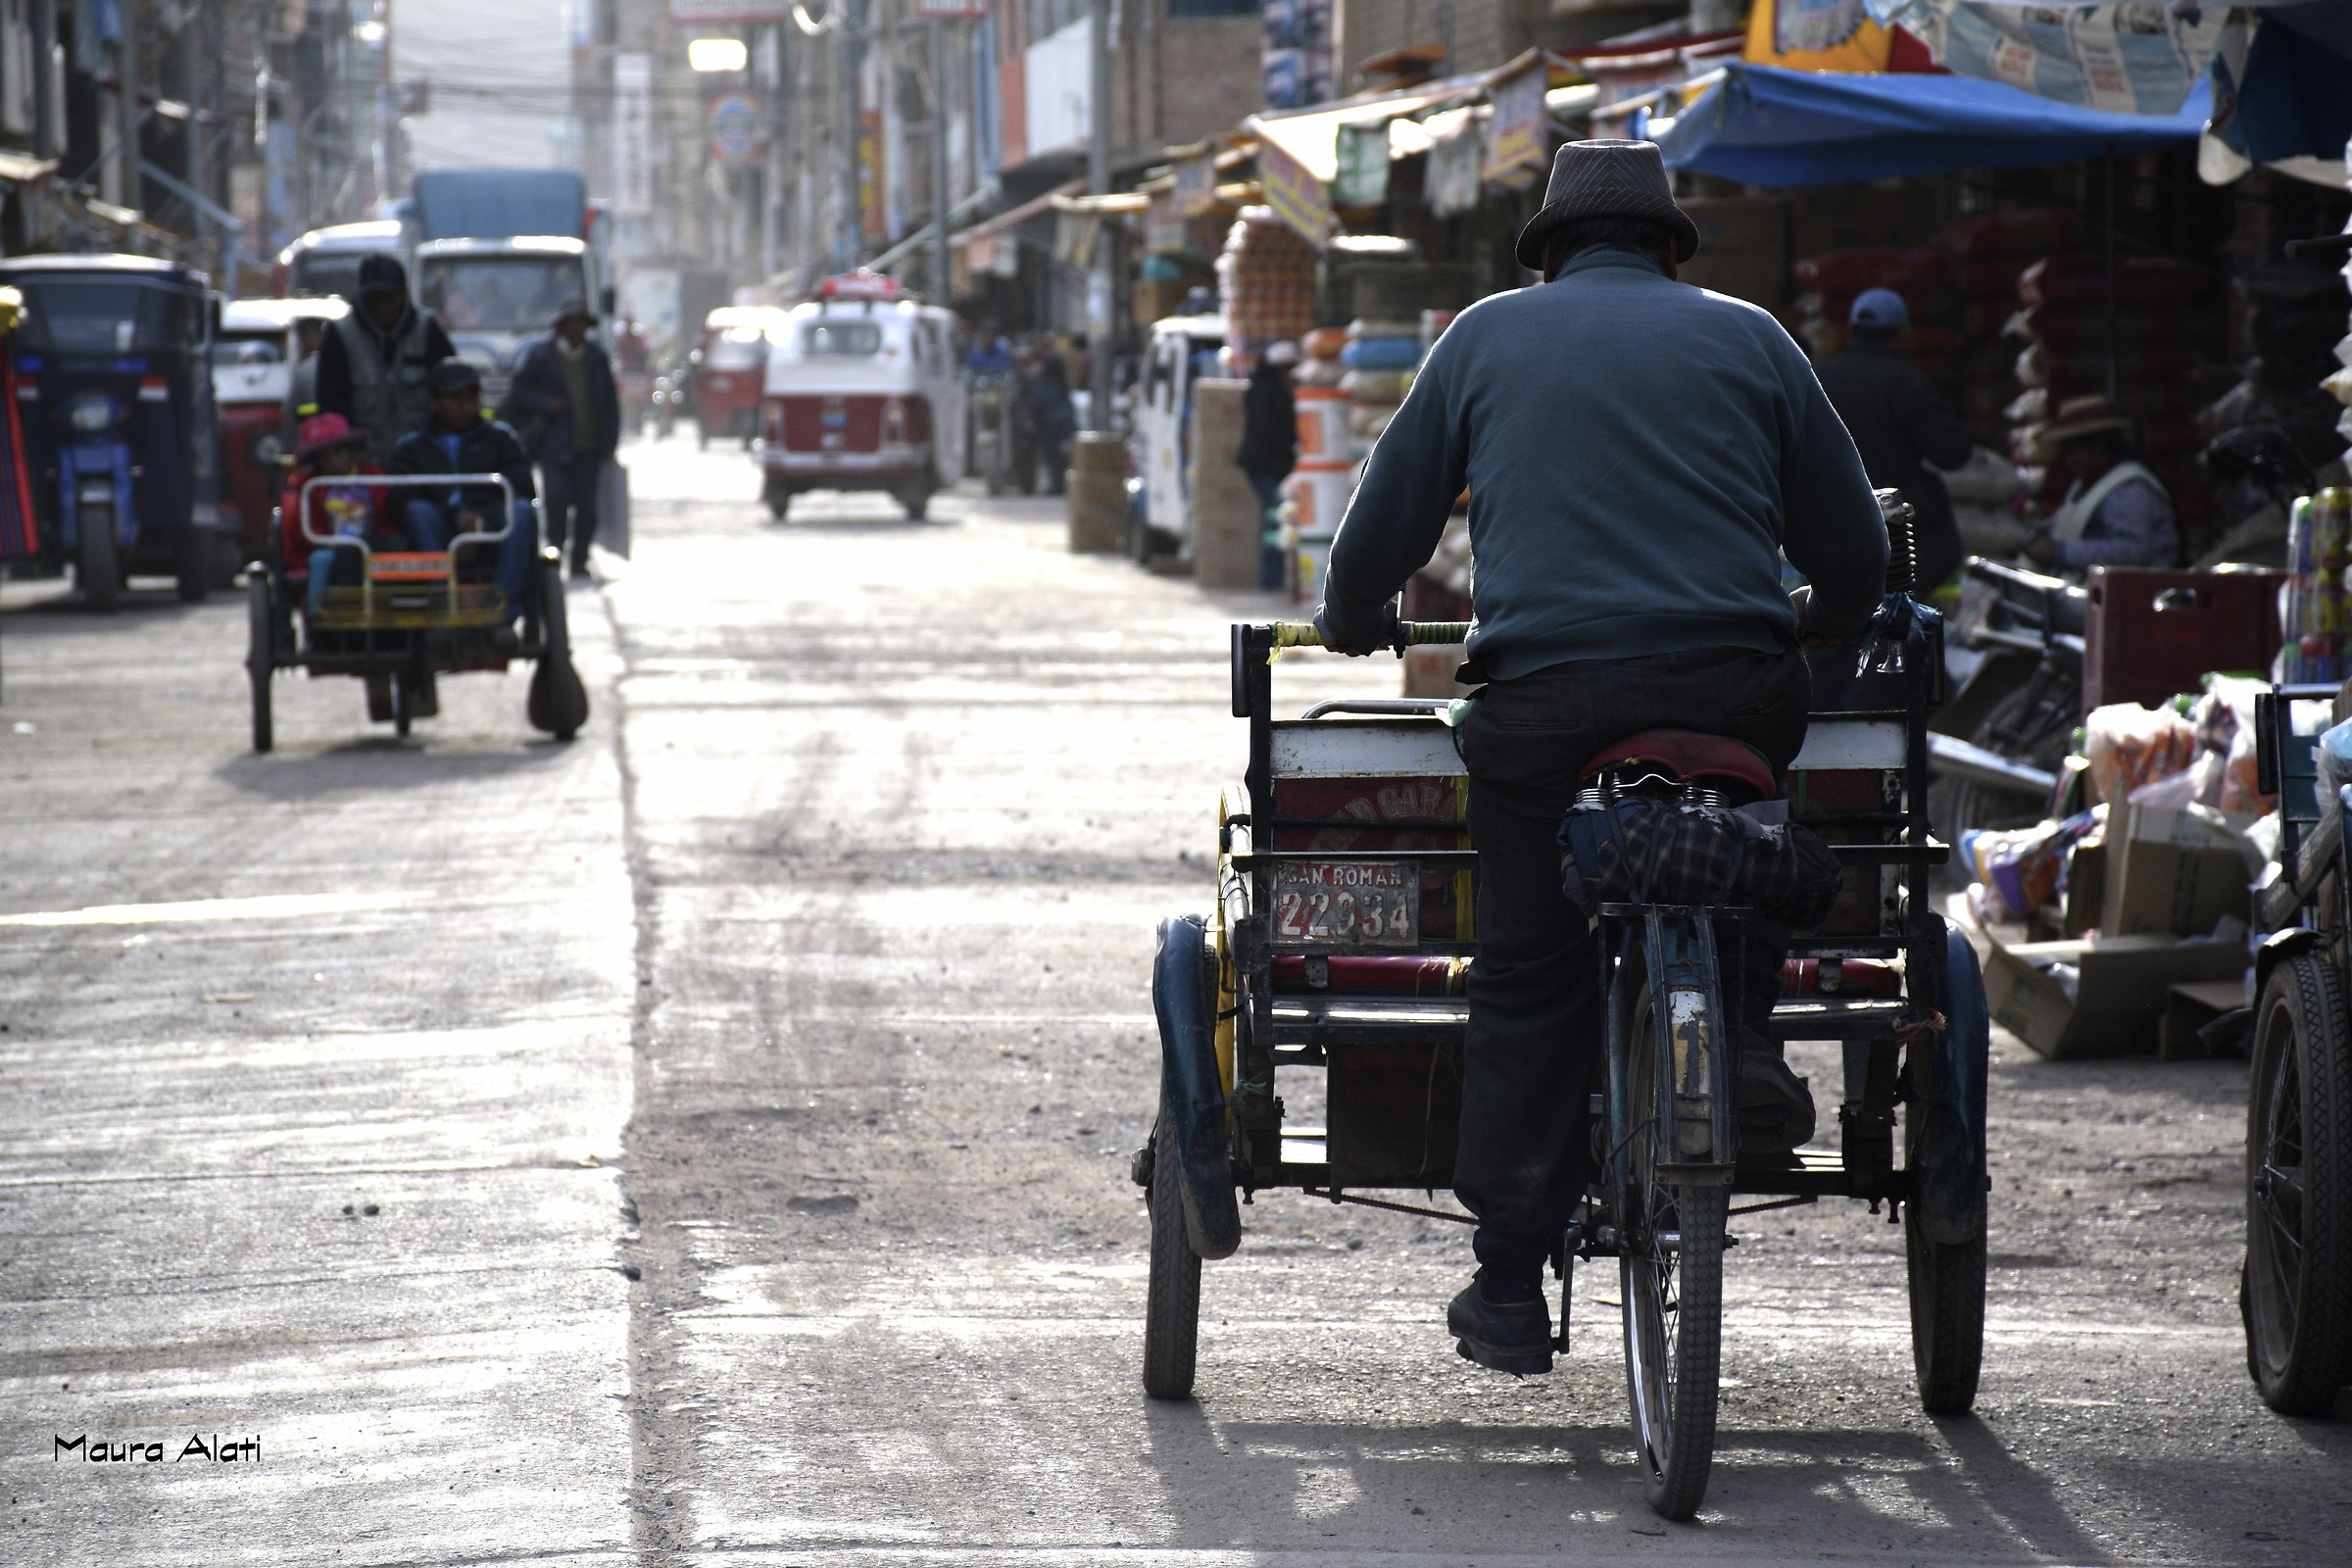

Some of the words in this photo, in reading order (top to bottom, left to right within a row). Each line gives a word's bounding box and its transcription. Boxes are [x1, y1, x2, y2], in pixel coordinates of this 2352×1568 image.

[1286, 867, 1323, 884] SAN
[1333, 867, 1401, 886] ROMAN
[1281, 892, 1410, 938] 22934
